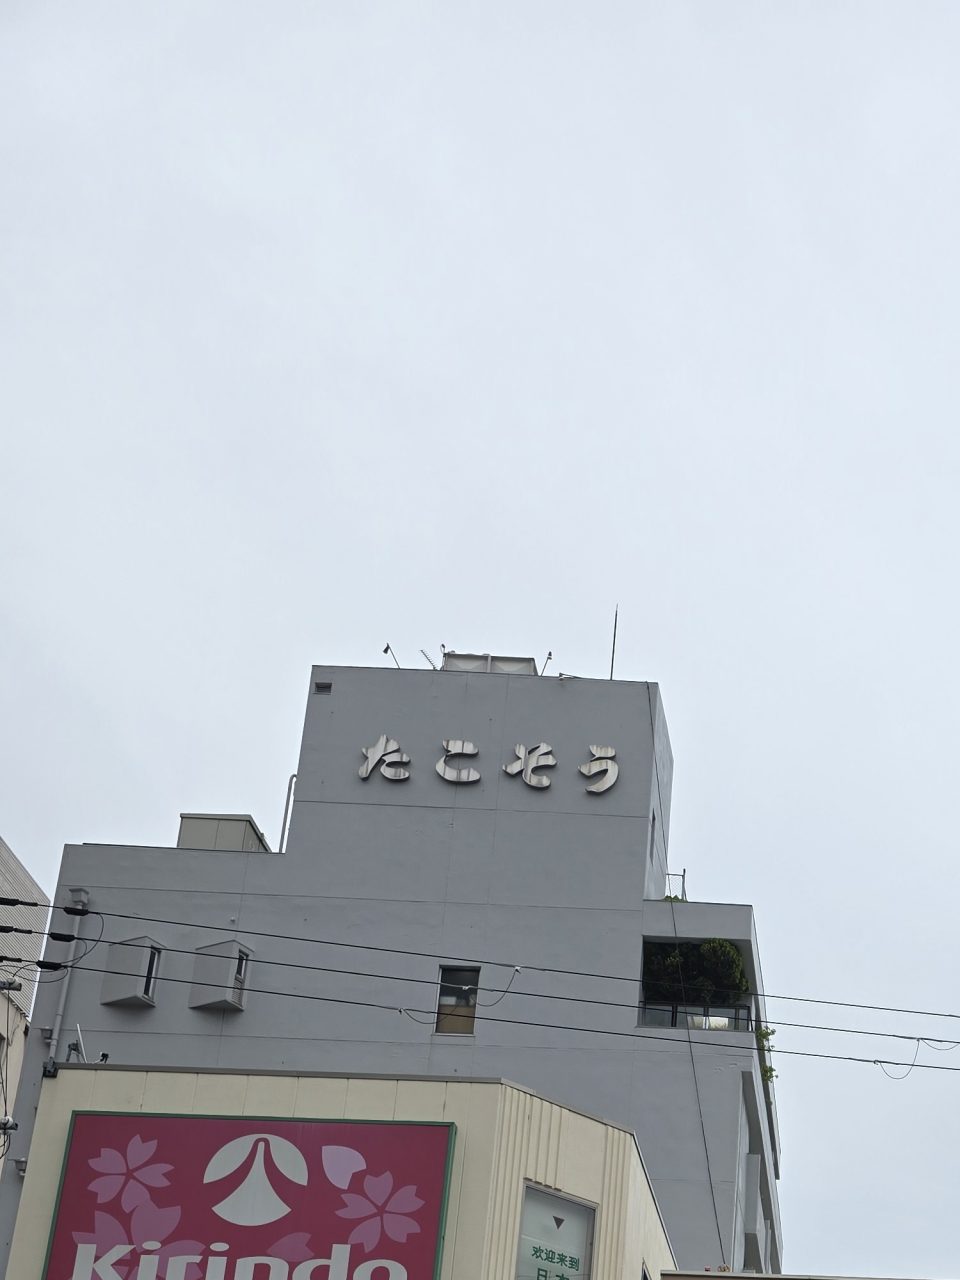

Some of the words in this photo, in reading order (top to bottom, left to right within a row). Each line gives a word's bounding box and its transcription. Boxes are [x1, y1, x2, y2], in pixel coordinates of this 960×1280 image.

[358, 733, 620, 794] たこそう
[532, 1244, 580, 1272] 欢迎来到
